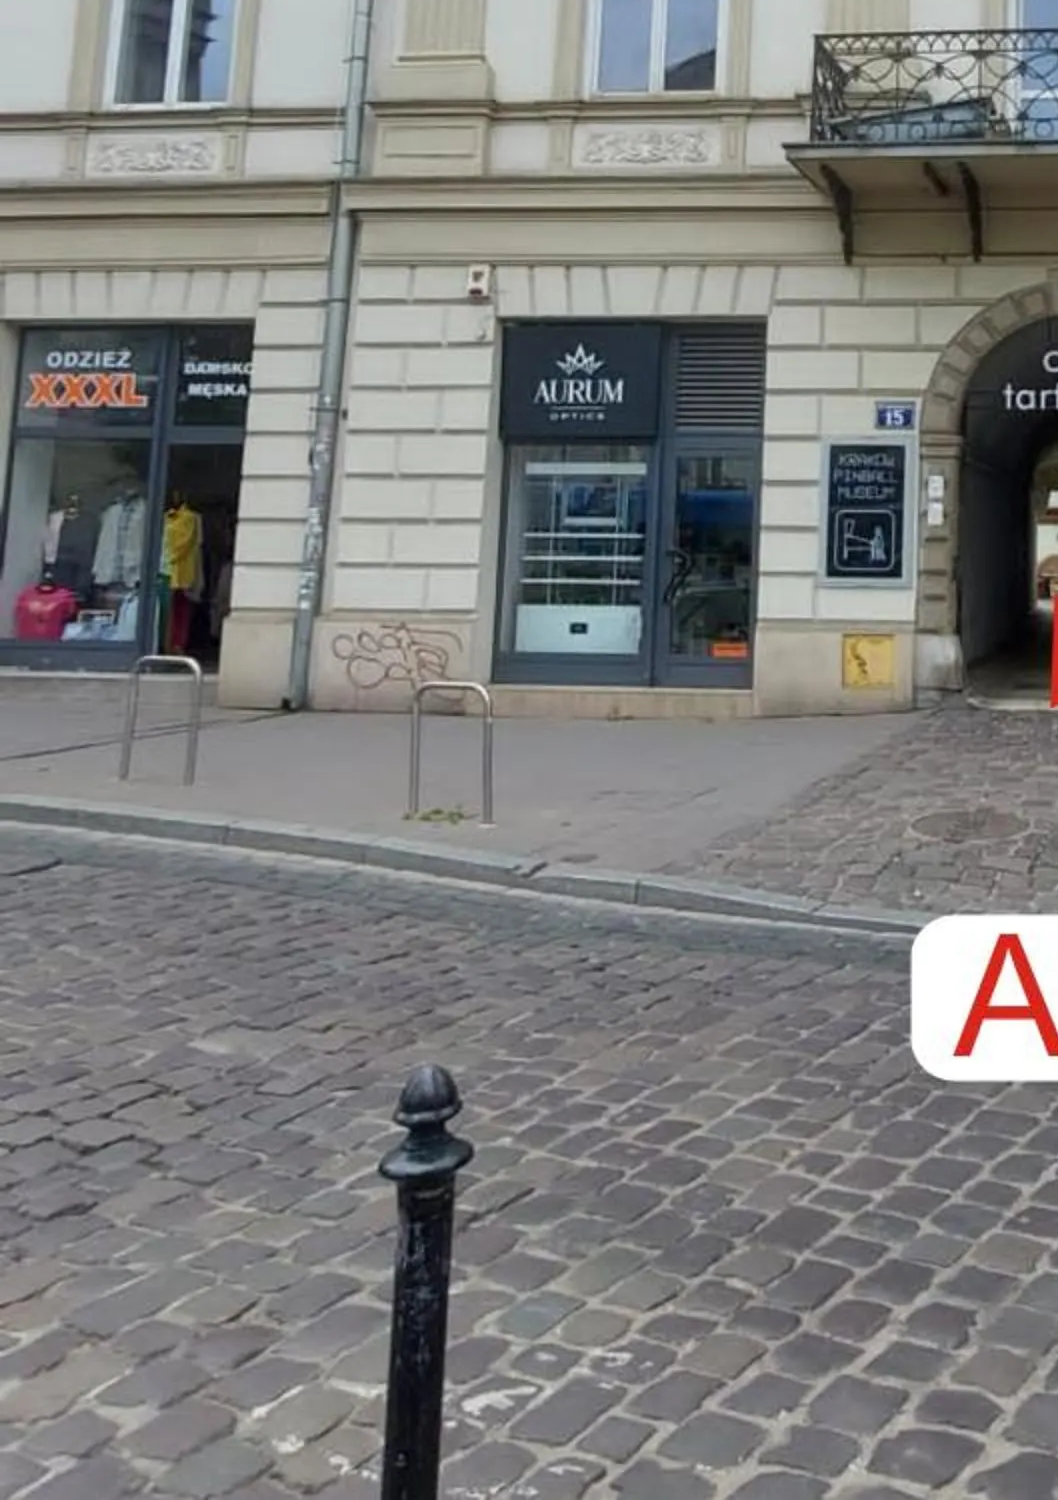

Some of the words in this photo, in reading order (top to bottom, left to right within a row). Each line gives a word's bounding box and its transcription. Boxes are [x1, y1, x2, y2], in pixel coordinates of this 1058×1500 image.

[47, 348, 132, 368] ODZIEŻ
[25, 373, 149, 408] XXXL
[188, 383, 247, 399] MĘSKA
[533, 378, 624, 404] AURUM
[885, 409, 904, 426] 15
